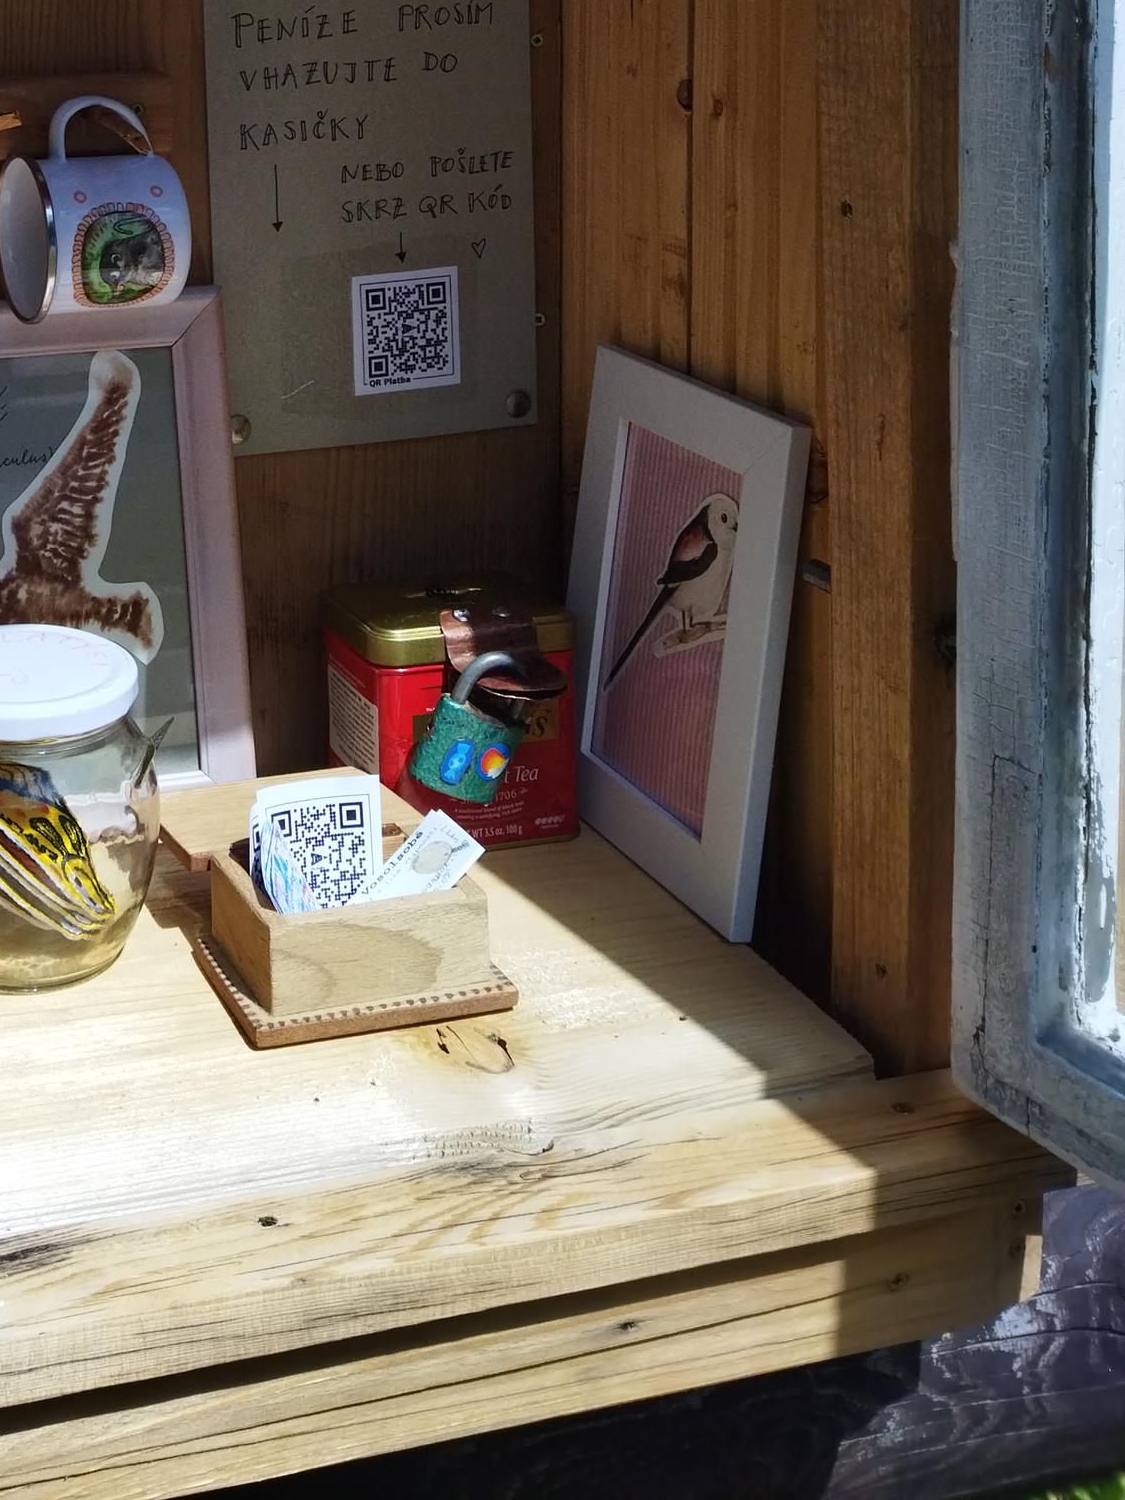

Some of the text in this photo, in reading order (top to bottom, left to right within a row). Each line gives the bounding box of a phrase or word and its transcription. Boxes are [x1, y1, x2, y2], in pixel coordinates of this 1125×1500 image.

[231, 5, 357, 48] PENÍZE
[240, 51, 458, 91] VHAZUJTE DO
[240, 108, 368, 151] KASIČKY
[341, 147, 513, 183] NEBO POŠLETE
[341, 184, 512, 223] SKRZ QR KÓD
[369, 376, 411, 388] QR Platba
[515, 765, 539, 783] Tea
